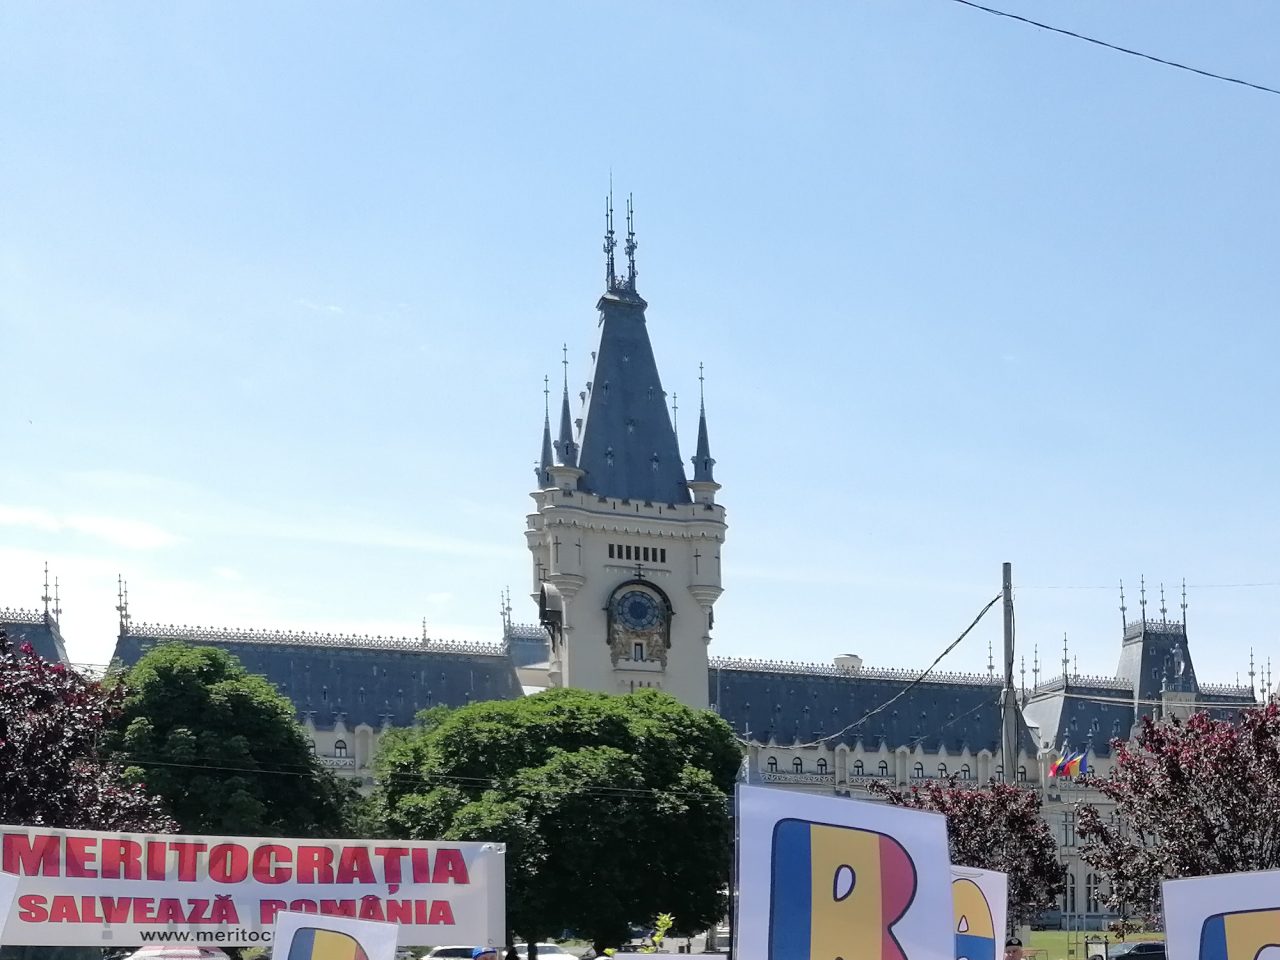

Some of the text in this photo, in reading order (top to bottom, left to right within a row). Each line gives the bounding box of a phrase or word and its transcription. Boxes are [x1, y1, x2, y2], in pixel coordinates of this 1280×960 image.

[2, 833, 471, 895] MERITOCRAȚIA
[18, 894, 241, 925] SALVEAZĂ
[139, 927, 275, 943] www.meritoc
